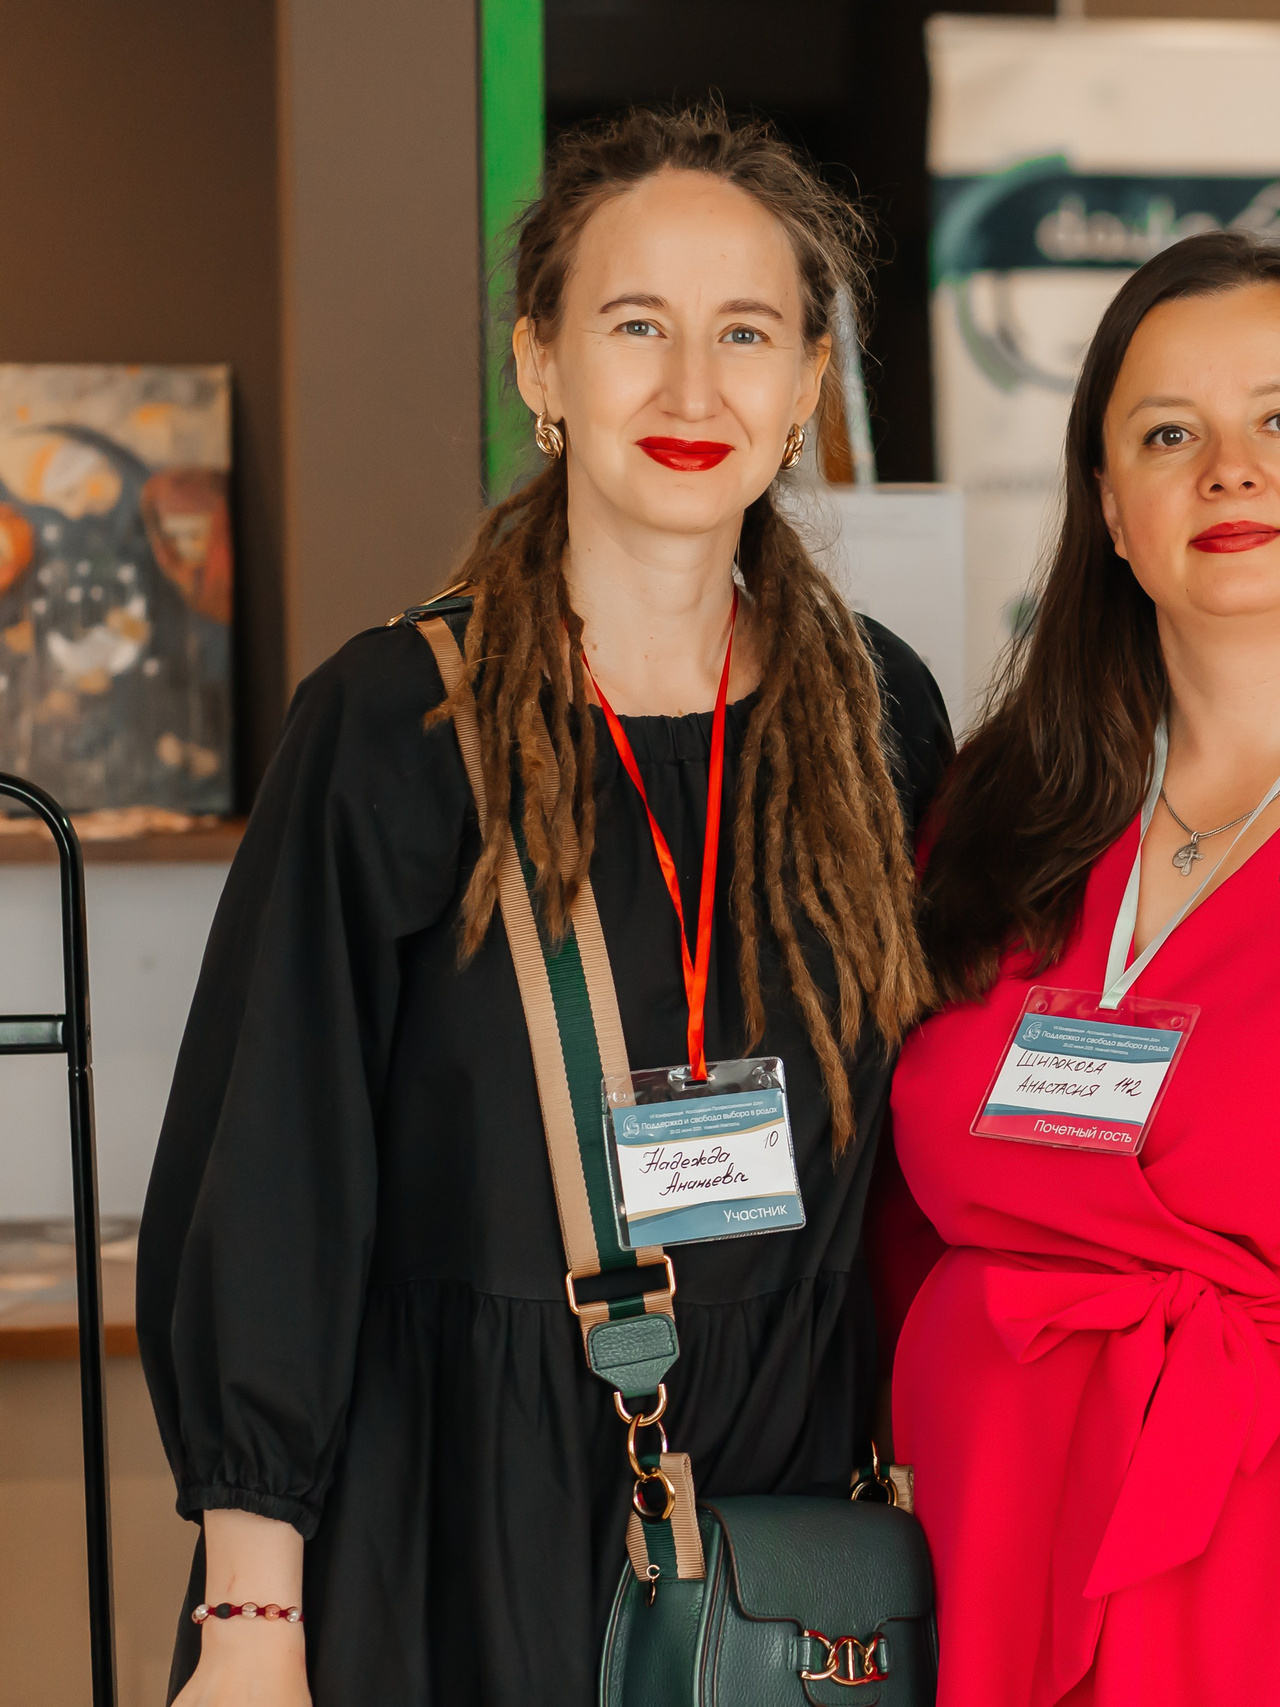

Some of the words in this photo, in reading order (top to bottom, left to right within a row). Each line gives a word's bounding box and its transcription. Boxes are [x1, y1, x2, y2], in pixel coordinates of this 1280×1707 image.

[1041, 1030, 1080, 1042] Поддержка
[1086, 1036, 1116, 1046] свобода
[1117, 1040, 1143, 1050] выбора
[1114, 1077, 1143, 1097] 142
[641, 1119, 684, 1130] Поддержка
[689, 1113, 722, 1124] свобода
[722, 1110, 750, 1121] выбора
[755, 1107, 778, 1117] родах
[764, 1130, 779, 1149] 10
[1034, 1119, 1096, 1139] Почетный
[1098, 1130, 1132, 1143] гость
[639, 1145, 731, 1174] Надежда
[723, 1204, 788, 1223] Участник
